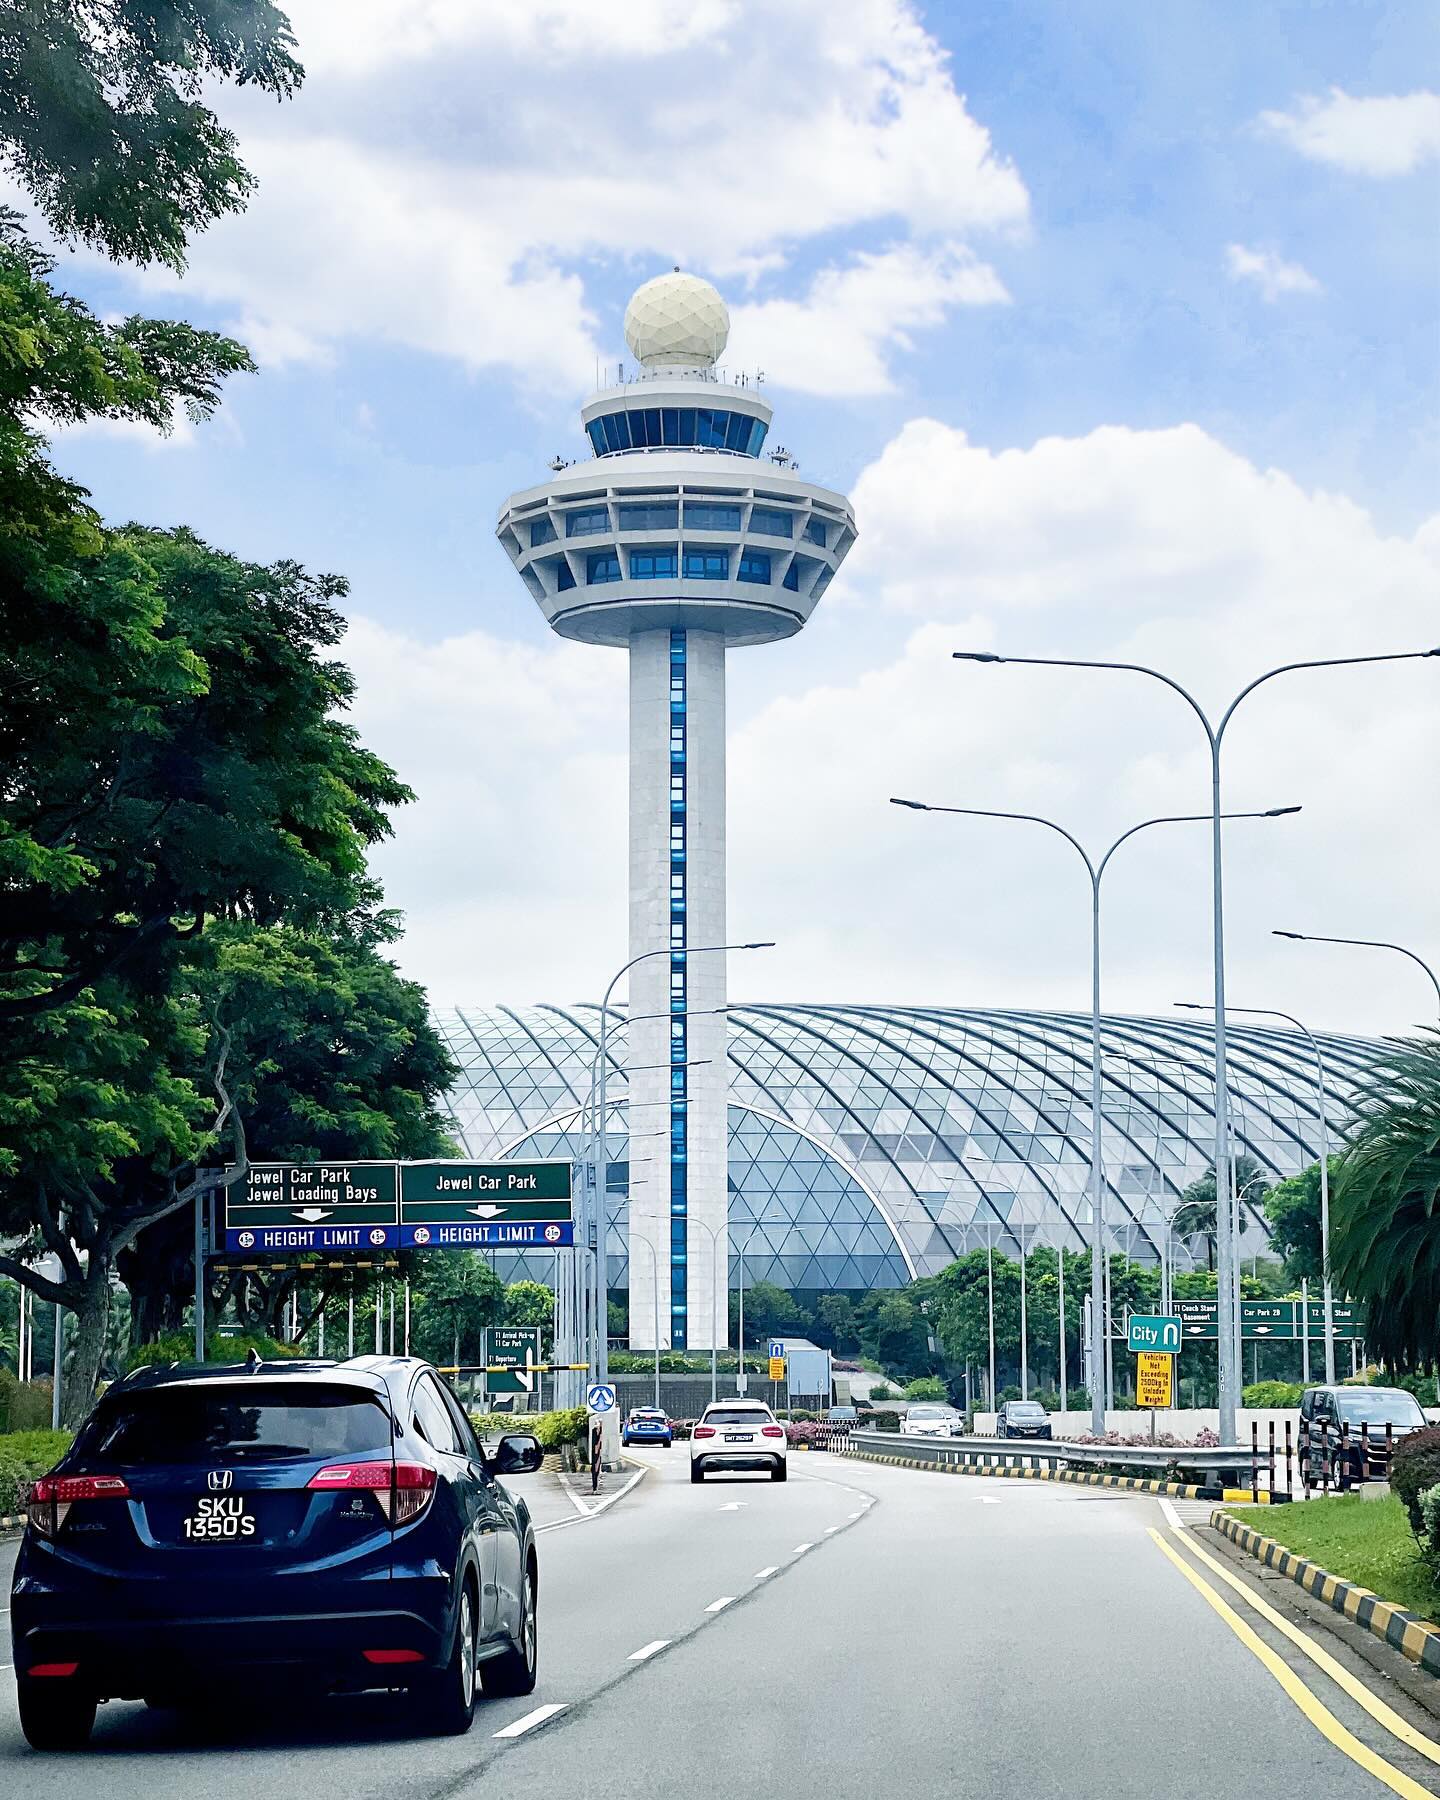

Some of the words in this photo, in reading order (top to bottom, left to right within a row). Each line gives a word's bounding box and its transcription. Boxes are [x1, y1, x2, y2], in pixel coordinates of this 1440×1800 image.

[247, 1170, 283, 1184] Jewel
[290, 1169, 313, 1184] Car
[321, 1168, 350, 1183] Park
[436, 1175, 472, 1190] Jewel
[478, 1175, 501, 1190] Car
[508, 1174, 537, 1189] Park
[247, 1187, 283, 1201] Jewel
[291, 1186, 338, 1203] Loading
[346, 1185, 377, 1202] Bays
[264, 1230, 314, 1246] HEIGHT
[323, 1230, 360, 1245] LIMIT
[440, 1227, 489, 1242] HEIGHT
[498, 1226, 535, 1241] LIMIT
[1132, 1326, 1158, 1344] City
[1140, 1370, 1169, 1380] Exceeding
[1144, 1396, 1164, 1405] Weight
[198, 1496, 243, 1518] SKU
[183, 1515, 256, 1538] 1350S
